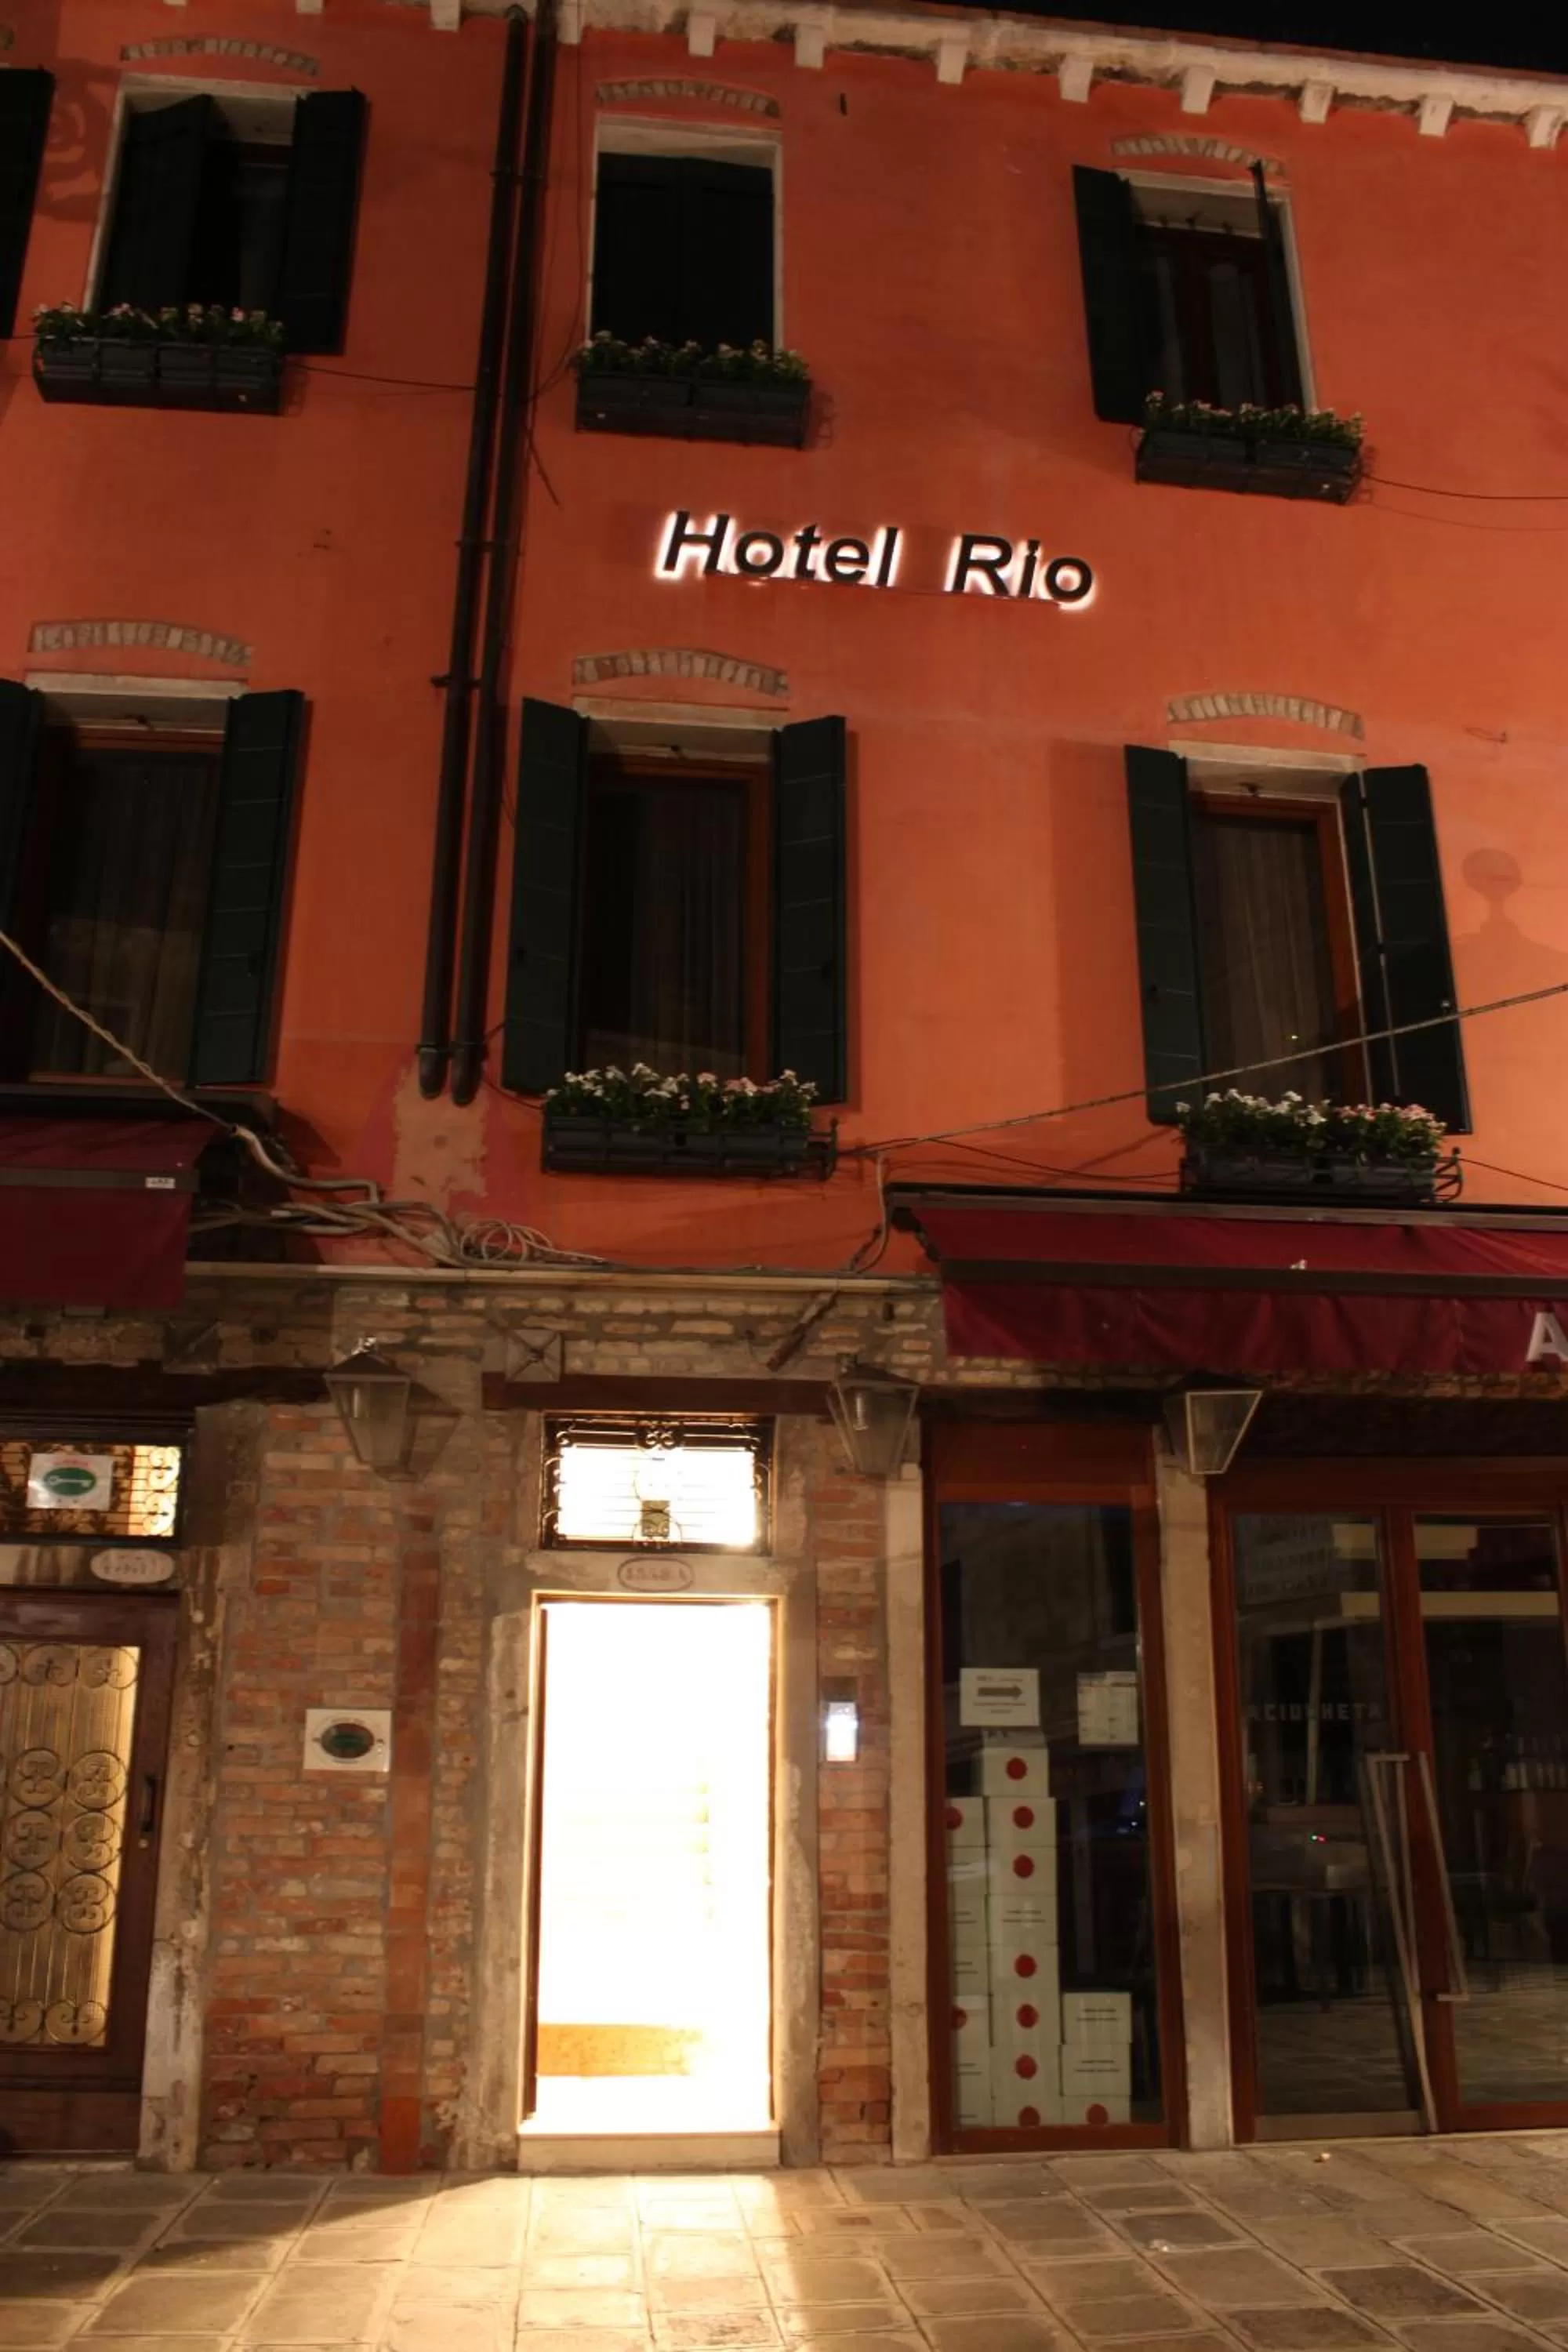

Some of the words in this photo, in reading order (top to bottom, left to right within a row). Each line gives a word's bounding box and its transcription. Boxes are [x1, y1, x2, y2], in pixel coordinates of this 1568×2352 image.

[657, 510, 901, 589] Hotel
[946, 532, 1094, 605] Rio
[1247, 1701, 1383, 1722] ACIUHETA
